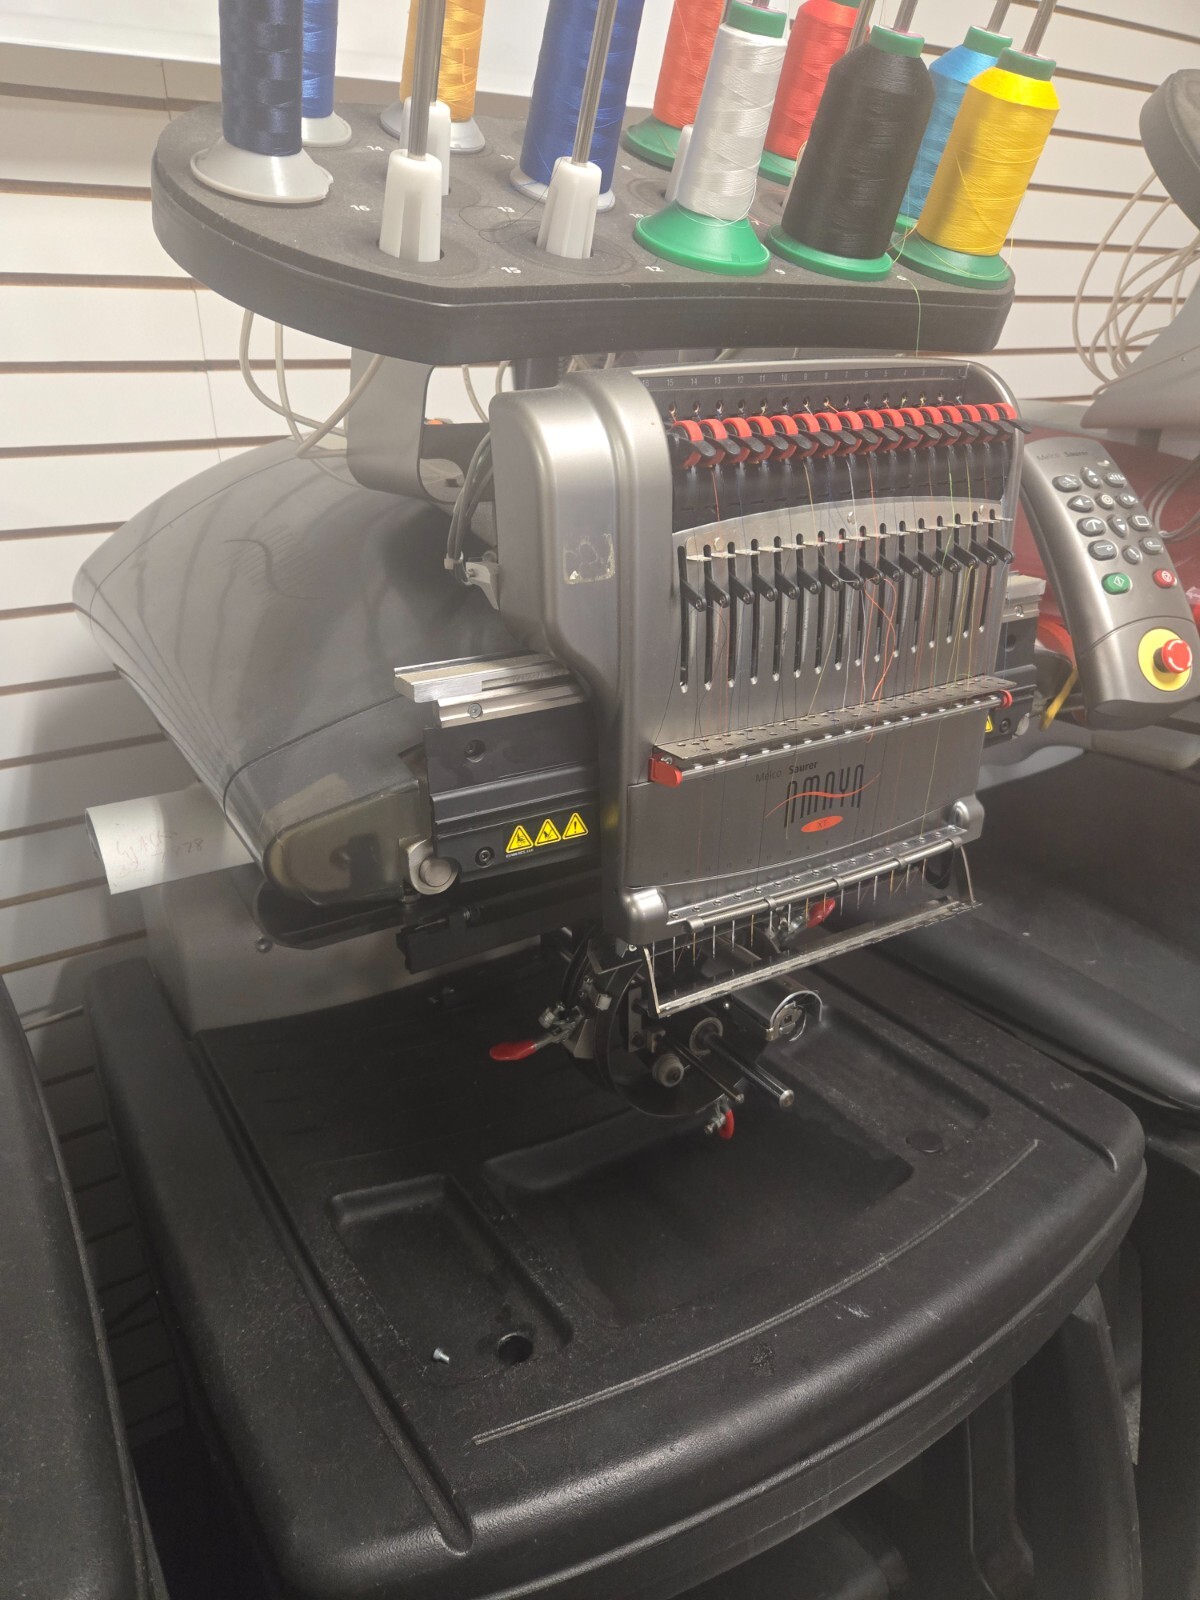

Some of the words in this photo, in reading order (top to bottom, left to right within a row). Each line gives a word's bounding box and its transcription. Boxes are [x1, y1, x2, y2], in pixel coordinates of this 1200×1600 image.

[350, 204, 371, 212] 16
[501, 266, 522, 274] 15
[645, 265, 664, 273] 12
[667, 378, 674, 387] 15
[690, 377, 698, 386] 14
[714, 376, 721, 385] 13
[737, 375, 744, 384] 12
[759, 374, 766, 383] 11
[781, 373, 788, 382] 10
[755, 770, 782, 783] Melco
[788, 761, 818, 775] Saurer
